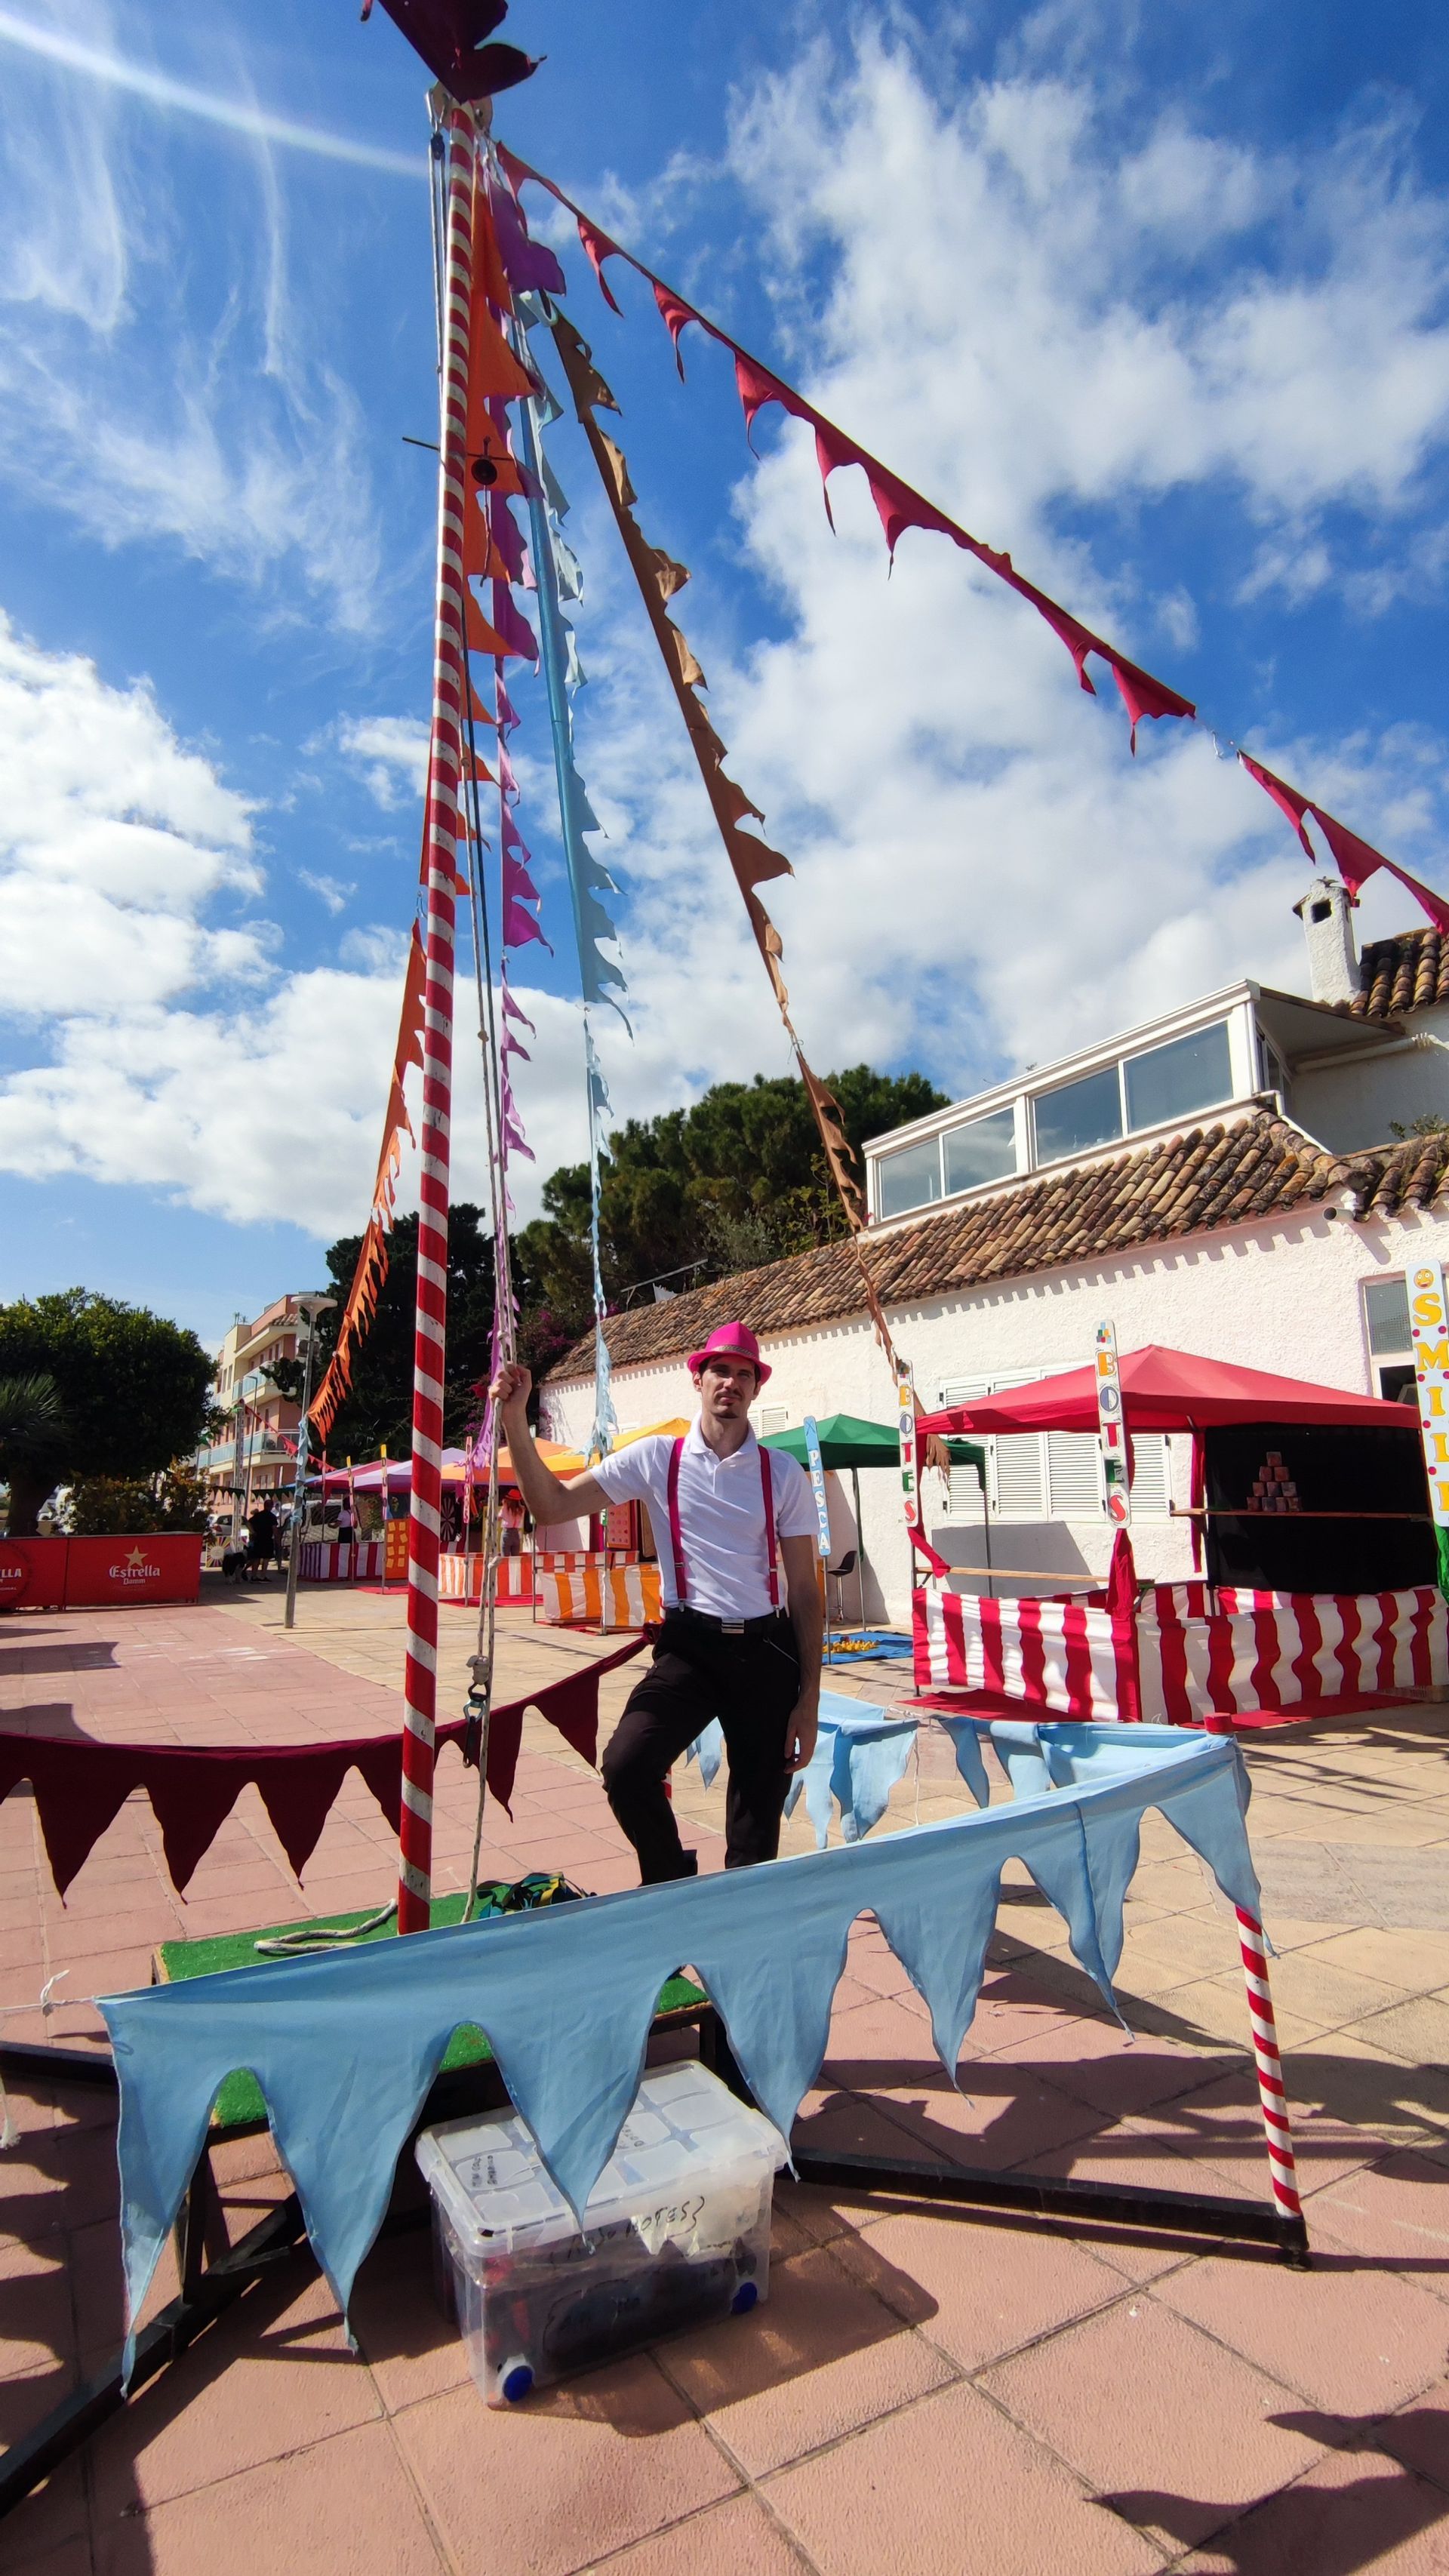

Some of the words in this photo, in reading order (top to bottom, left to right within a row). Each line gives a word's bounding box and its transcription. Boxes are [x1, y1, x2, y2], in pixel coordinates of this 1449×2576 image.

[899, 1384, 917, 1522] BOTES
[1097, 1351, 1126, 1522] BOTES
[809, 1449, 830, 1550] PESCA
[109, 1565, 160, 1578] Estrella
